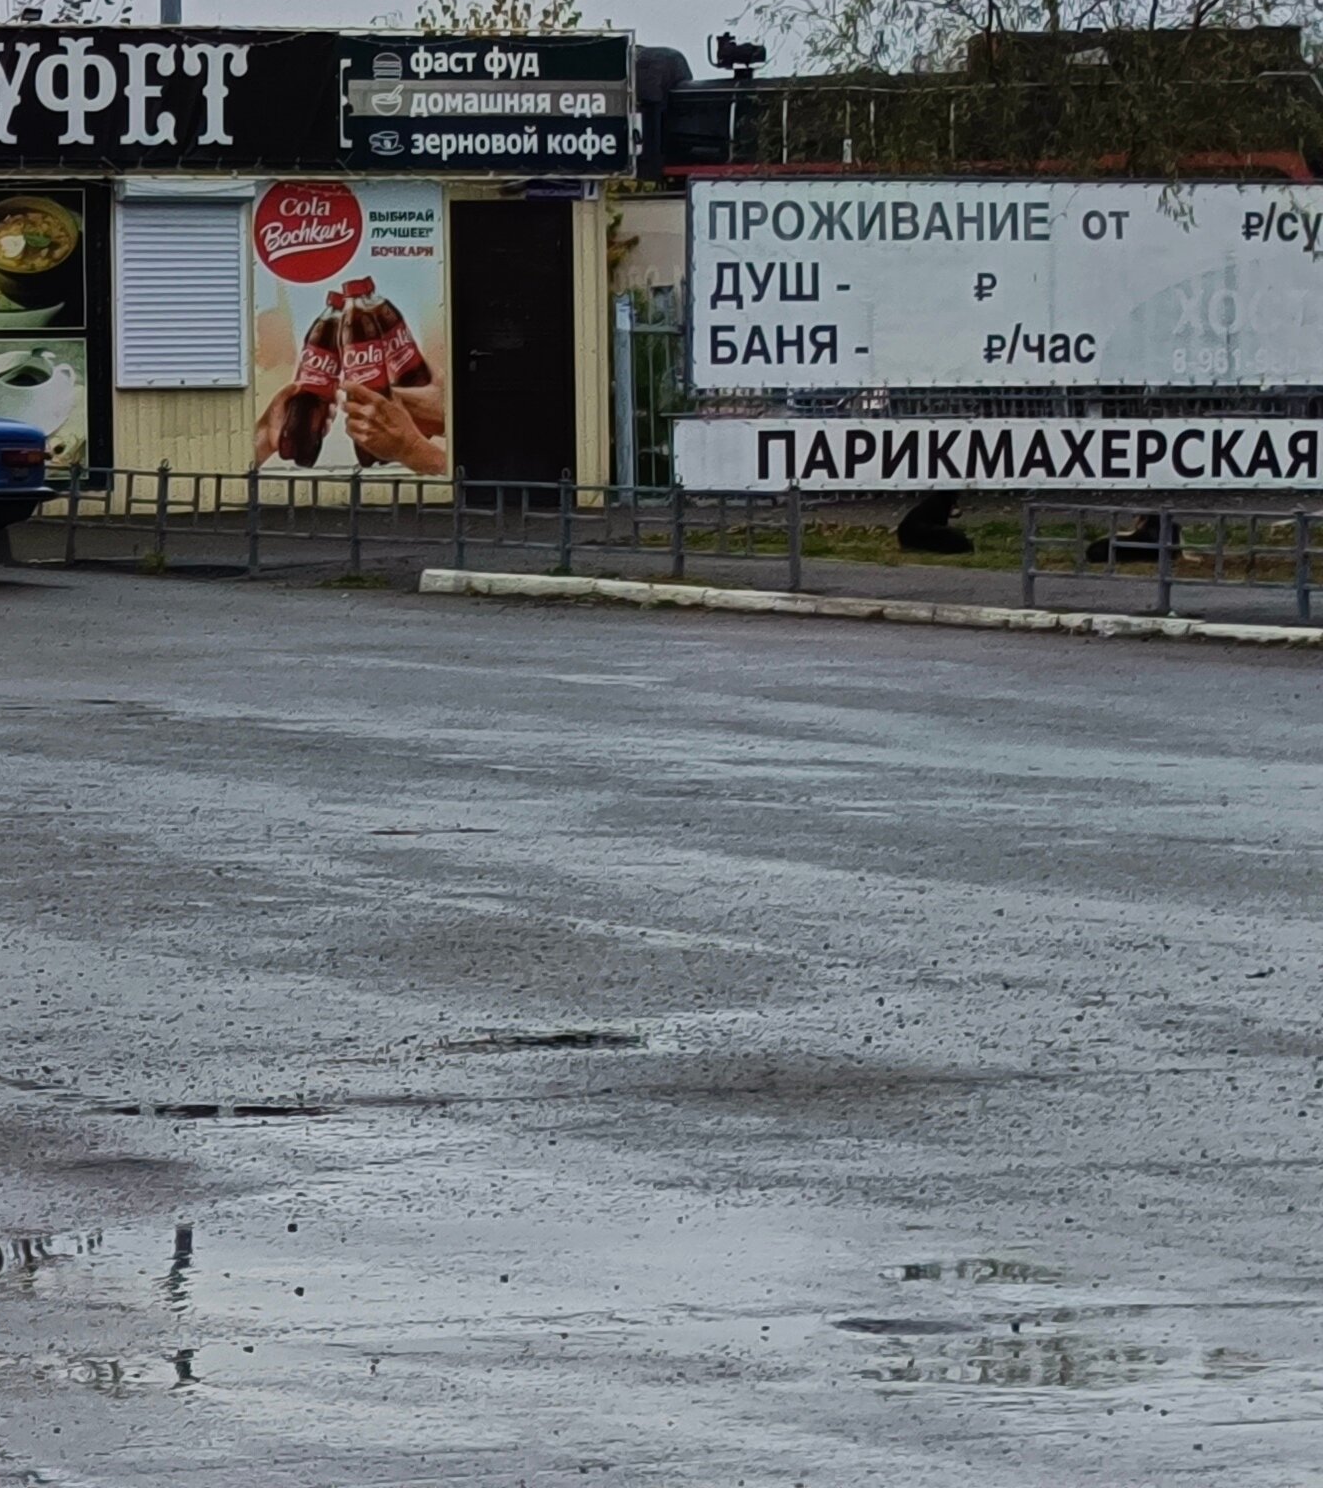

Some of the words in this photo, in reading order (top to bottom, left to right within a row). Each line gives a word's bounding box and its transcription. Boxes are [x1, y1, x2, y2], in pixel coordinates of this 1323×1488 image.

[410, 46, 476, 79] фаст
[484, 46, 539, 79] фуд
[410, 93, 551, 117] домашняя
[559, 93, 606, 118] еда
[411, 125, 539, 160] зерновой
[547, 127, 617, 161] кофе
[279, 195, 331, 217] Cola
[369, 208, 435, 222] ВЫБИРАЙ
[708, 201, 1051, 241] ПРОЖИВАНИЕ
[1082, 210, 1130, 240] от
[710, 262, 820, 310] ДУШ
[343, 345, 383, 368] Cola
[710, 325, 839, 365] БАНЯ
[757, 428, 1318, 480] ПАРИКМАХЕРСКАЯ
